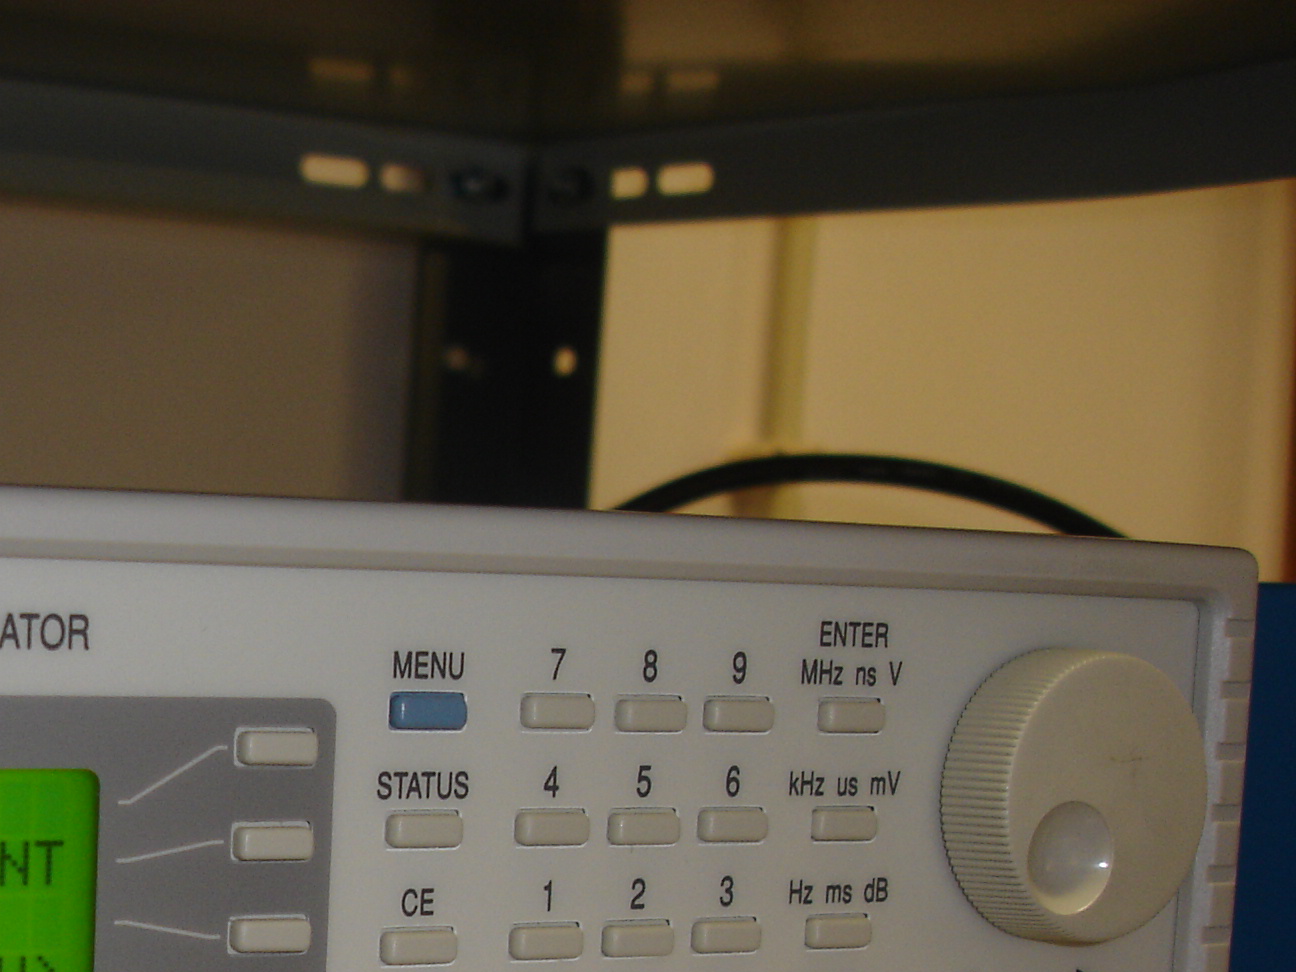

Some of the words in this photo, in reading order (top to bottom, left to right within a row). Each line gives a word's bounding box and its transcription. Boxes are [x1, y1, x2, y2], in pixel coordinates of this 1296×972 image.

[819, 620, 889, 648] ENTER
[393, 650, 465, 679] MENU
[550, 647, 567, 681] 7
[642, 650, 658, 682] 8
[732, 650, 747, 685] 9
[801, 658, 843, 686] MHz
[855, 666, 877, 686] ns
[889, 661, 903, 686] V
[376, 771, 469, 801] STATUS
[543, 766, 560, 798] 4
[635, 765, 653, 797] 5
[725, 765, 740, 797] 6
[788, 770, 825, 797] kHz
[837, 776, 859, 797] us
[869, 770, 901, 796] mV
[401, 888, 434, 917] CE
[543, 879, 554, 912] 1
[630, 879, 646, 911] 2
[719, 875, 734, 907] 3
[788, 879, 813, 904] Hz
[825, 883, 853, 904] ms
[864, 877, 889, 903] dB
